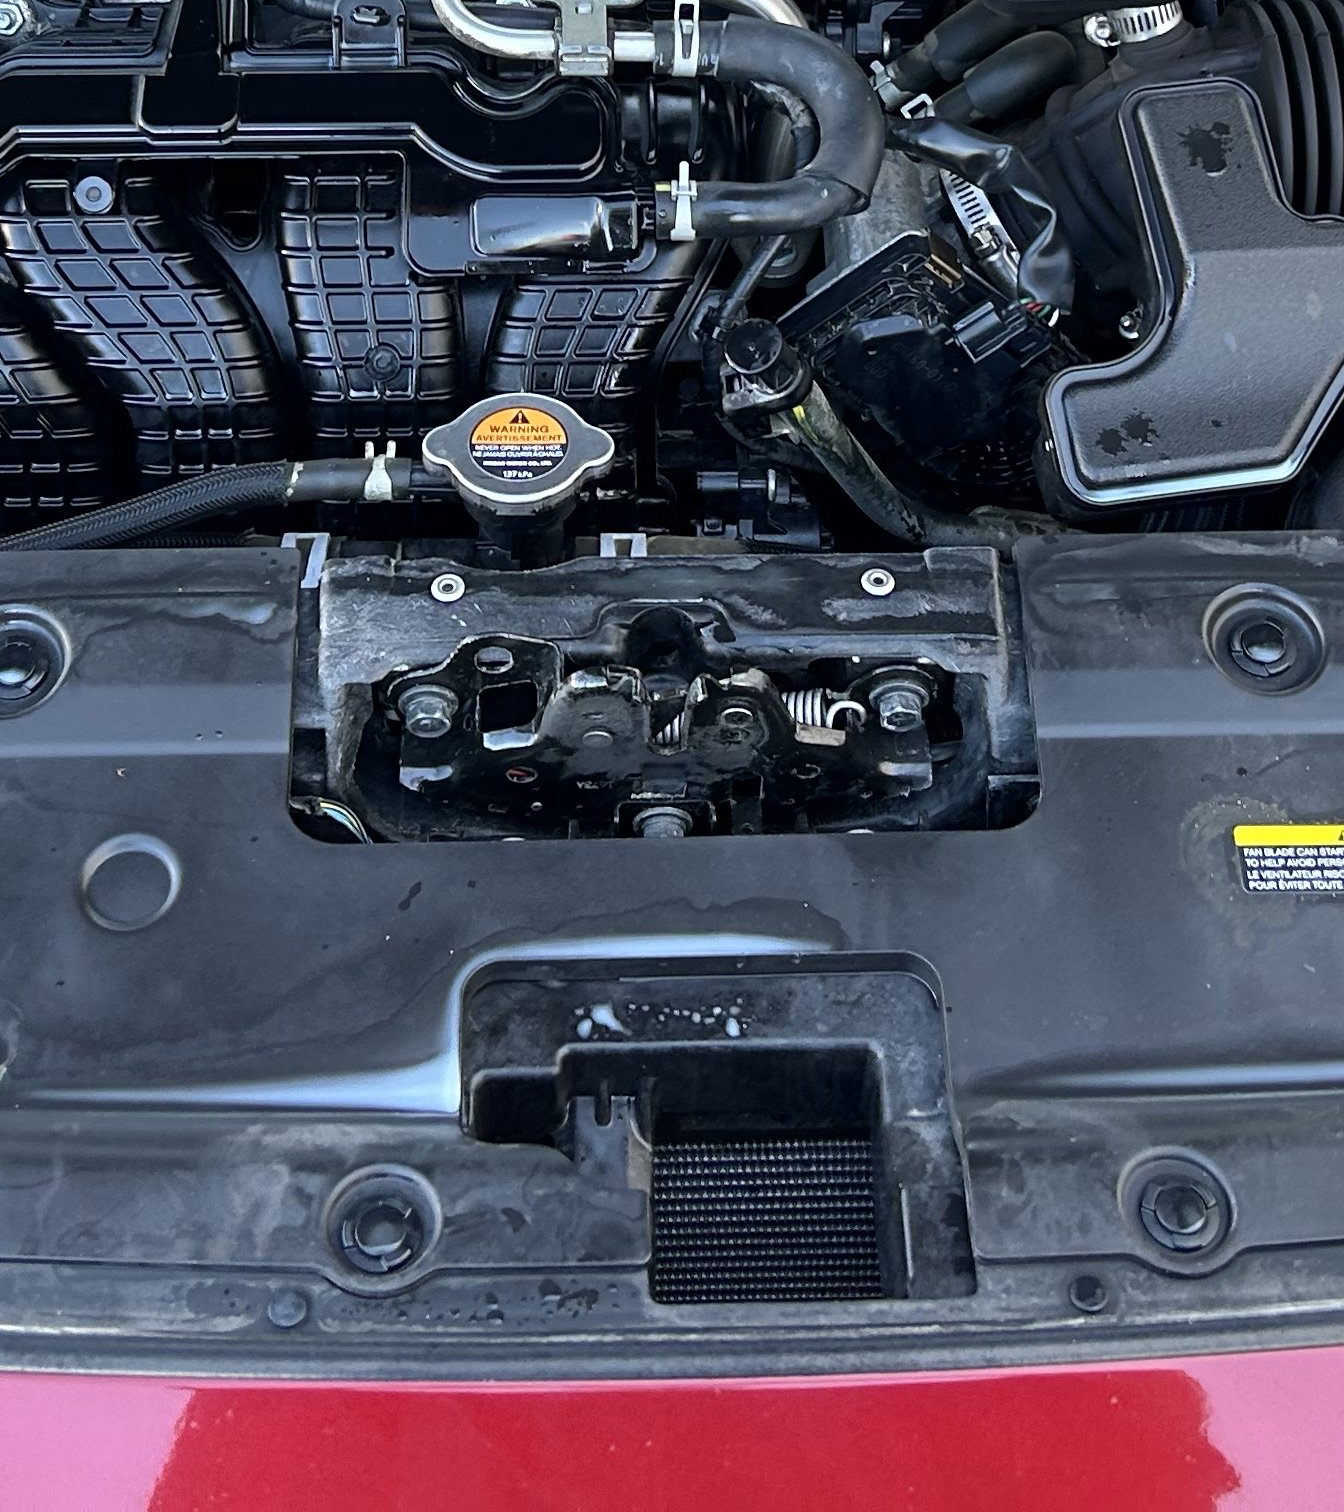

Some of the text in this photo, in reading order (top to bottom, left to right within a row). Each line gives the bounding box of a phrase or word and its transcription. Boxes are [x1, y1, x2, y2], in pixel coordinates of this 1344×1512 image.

[489, 425, 549, 433] WARNING
[476, 434, 562, 442] AVERTISSEMENT
[1243, 847, 1262, 857] FAN
[1264, 847, 1295, 857] BLADE
[1296, 847, 1318, 857] CAN
[1245, 857, 1259, 867] TO
[1260, 857, 1285, 867] HELP
[1287, 857, 1316, 867] AVOID
[1247, 869, 1259, 879] LE
[1261, 869, 1321, 879] VENTILATEUR
[1249, 879, 1277, 890] POUR
[1312, 879, 1343, 890] TOUTE
